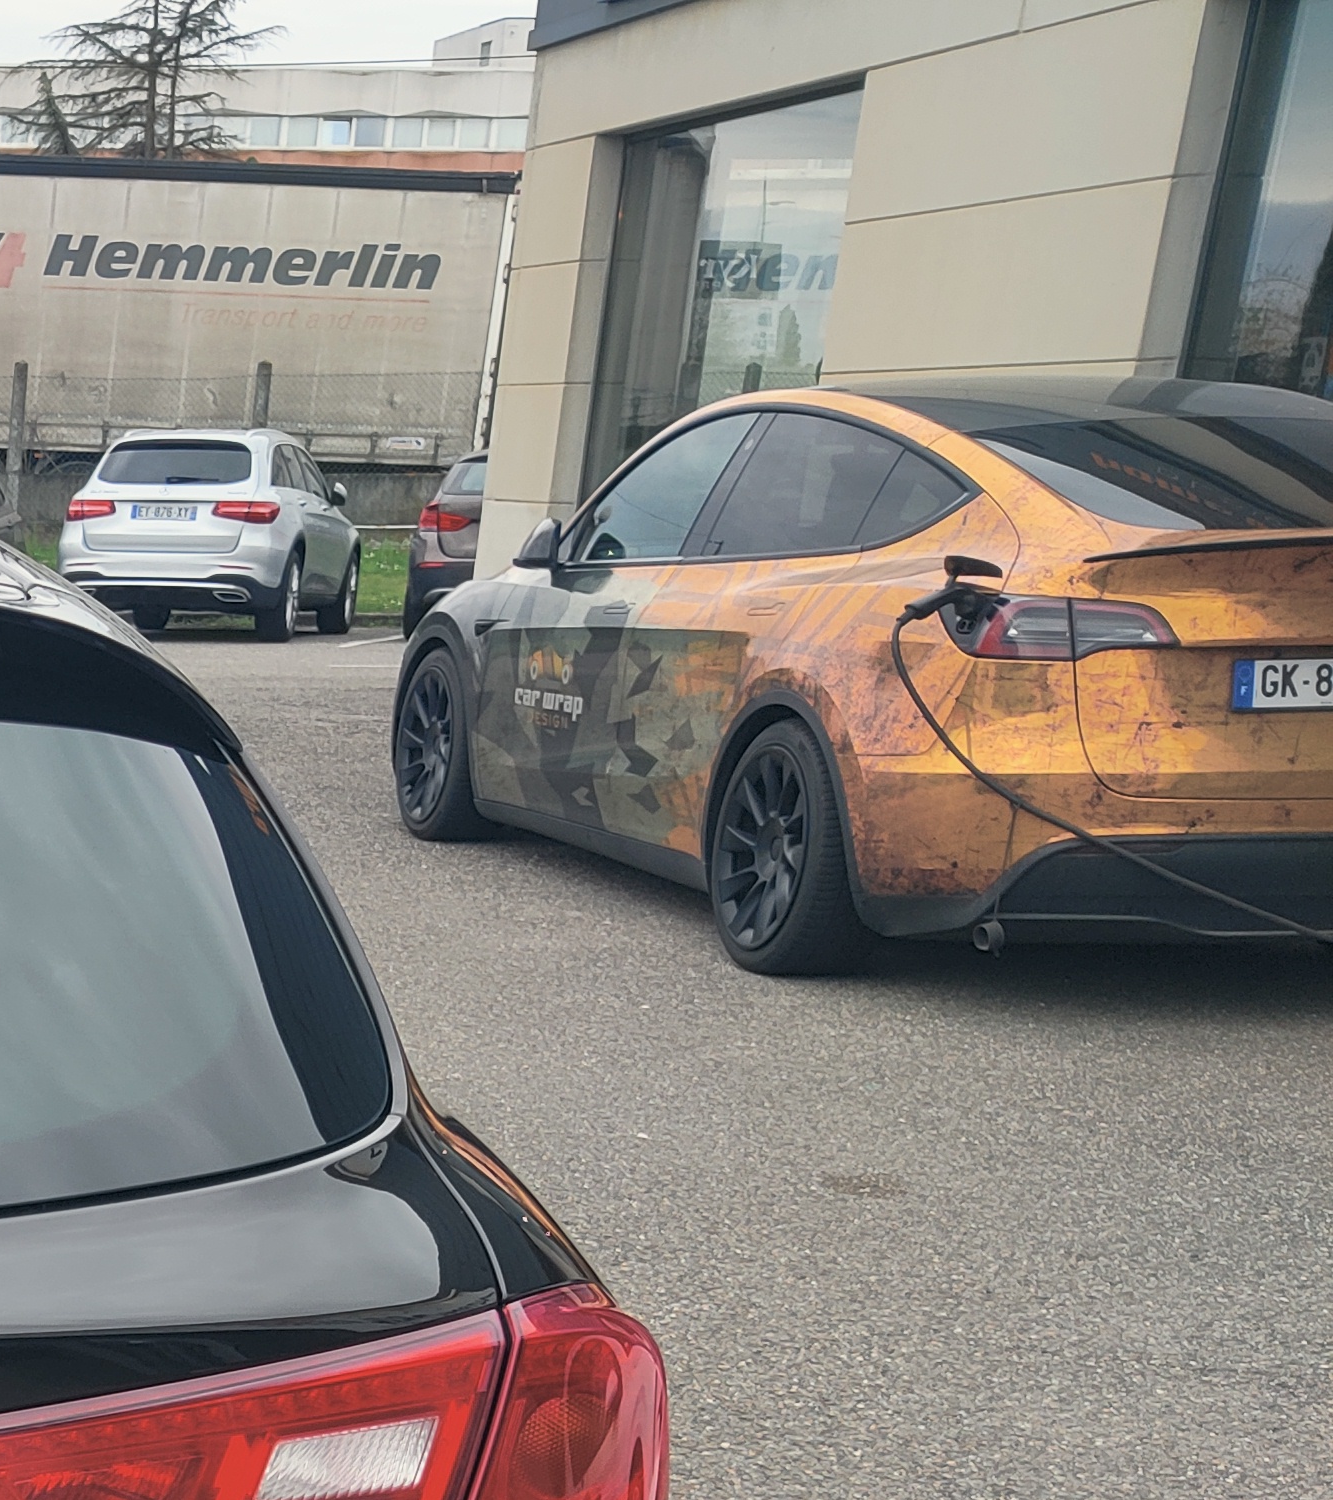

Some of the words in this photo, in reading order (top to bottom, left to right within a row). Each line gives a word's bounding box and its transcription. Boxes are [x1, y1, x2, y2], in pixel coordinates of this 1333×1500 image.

[43, 233, 442, 291] Hemmerlin
[514, 687, 541, 707] car
[542, 691, 584, 722] wrap
